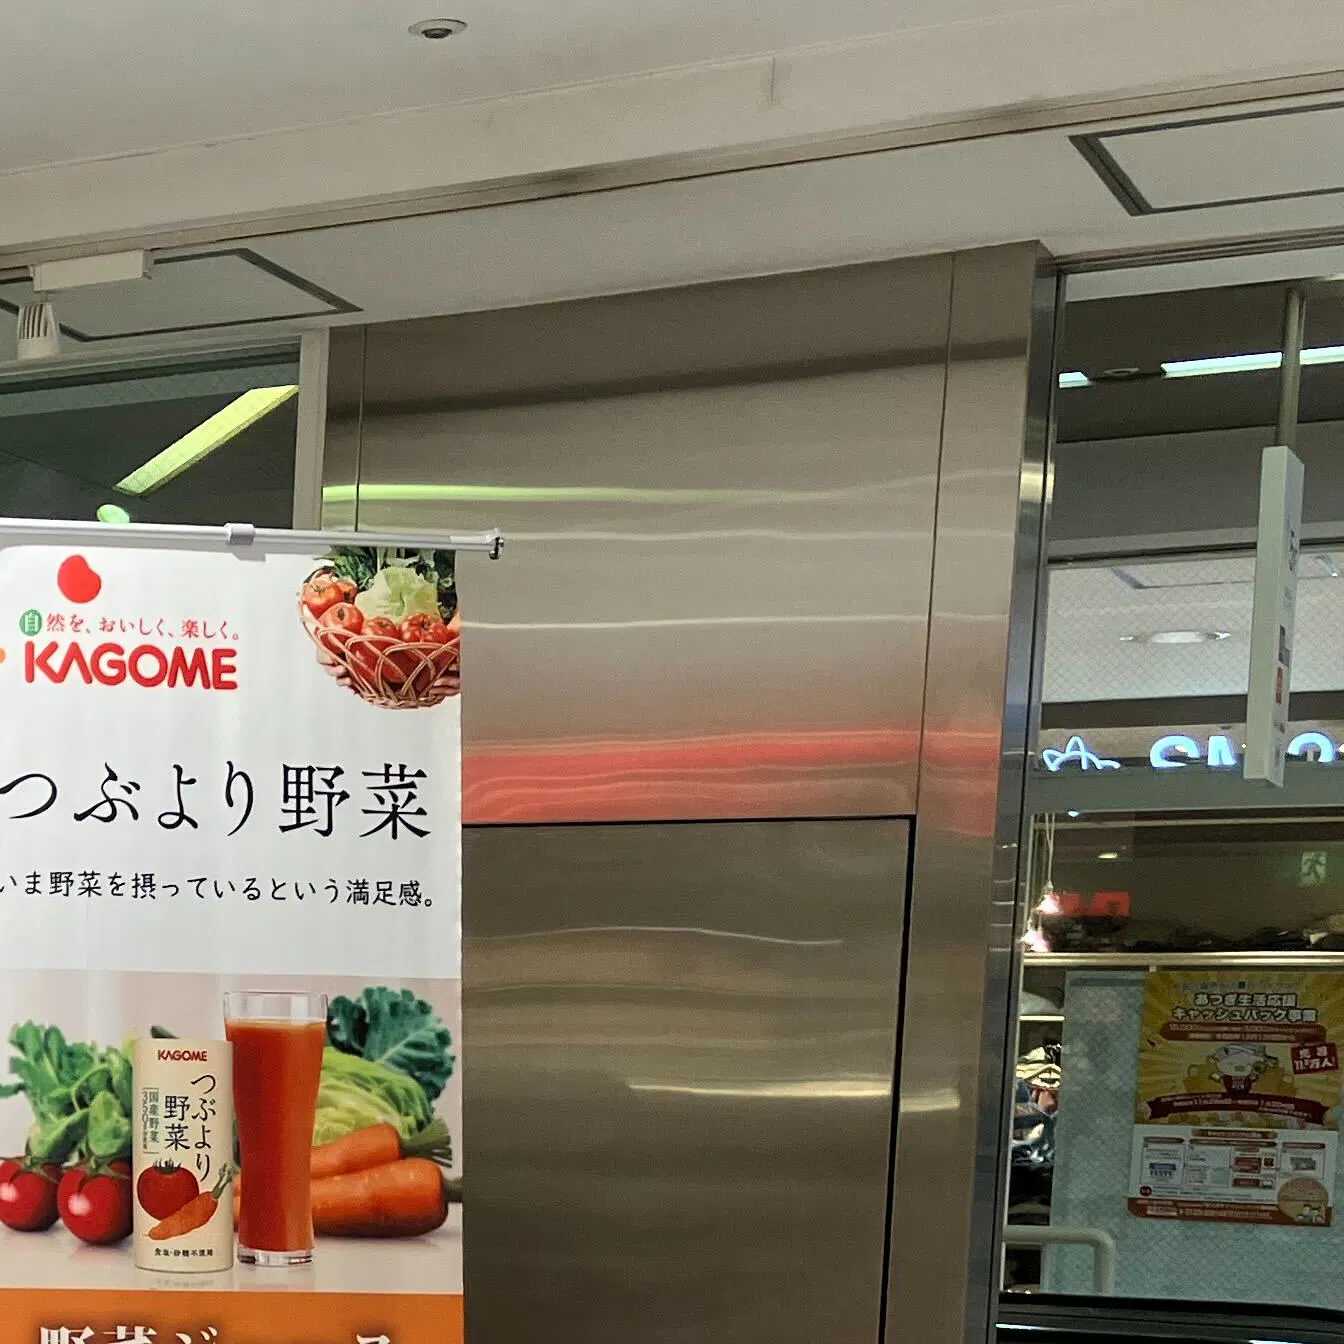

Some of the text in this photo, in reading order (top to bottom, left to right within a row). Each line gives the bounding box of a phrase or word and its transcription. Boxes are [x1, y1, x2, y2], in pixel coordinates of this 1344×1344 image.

[20, 609, 240, 641] 自然を、おいしく、楽しく。
[24, 641, 238, 690] KAGOME
[158, 1050, 208, 1061] KAGOME
[164, 1096, 190, 1151] 野菜
[191, 1074, 216, 1182] つぶより
